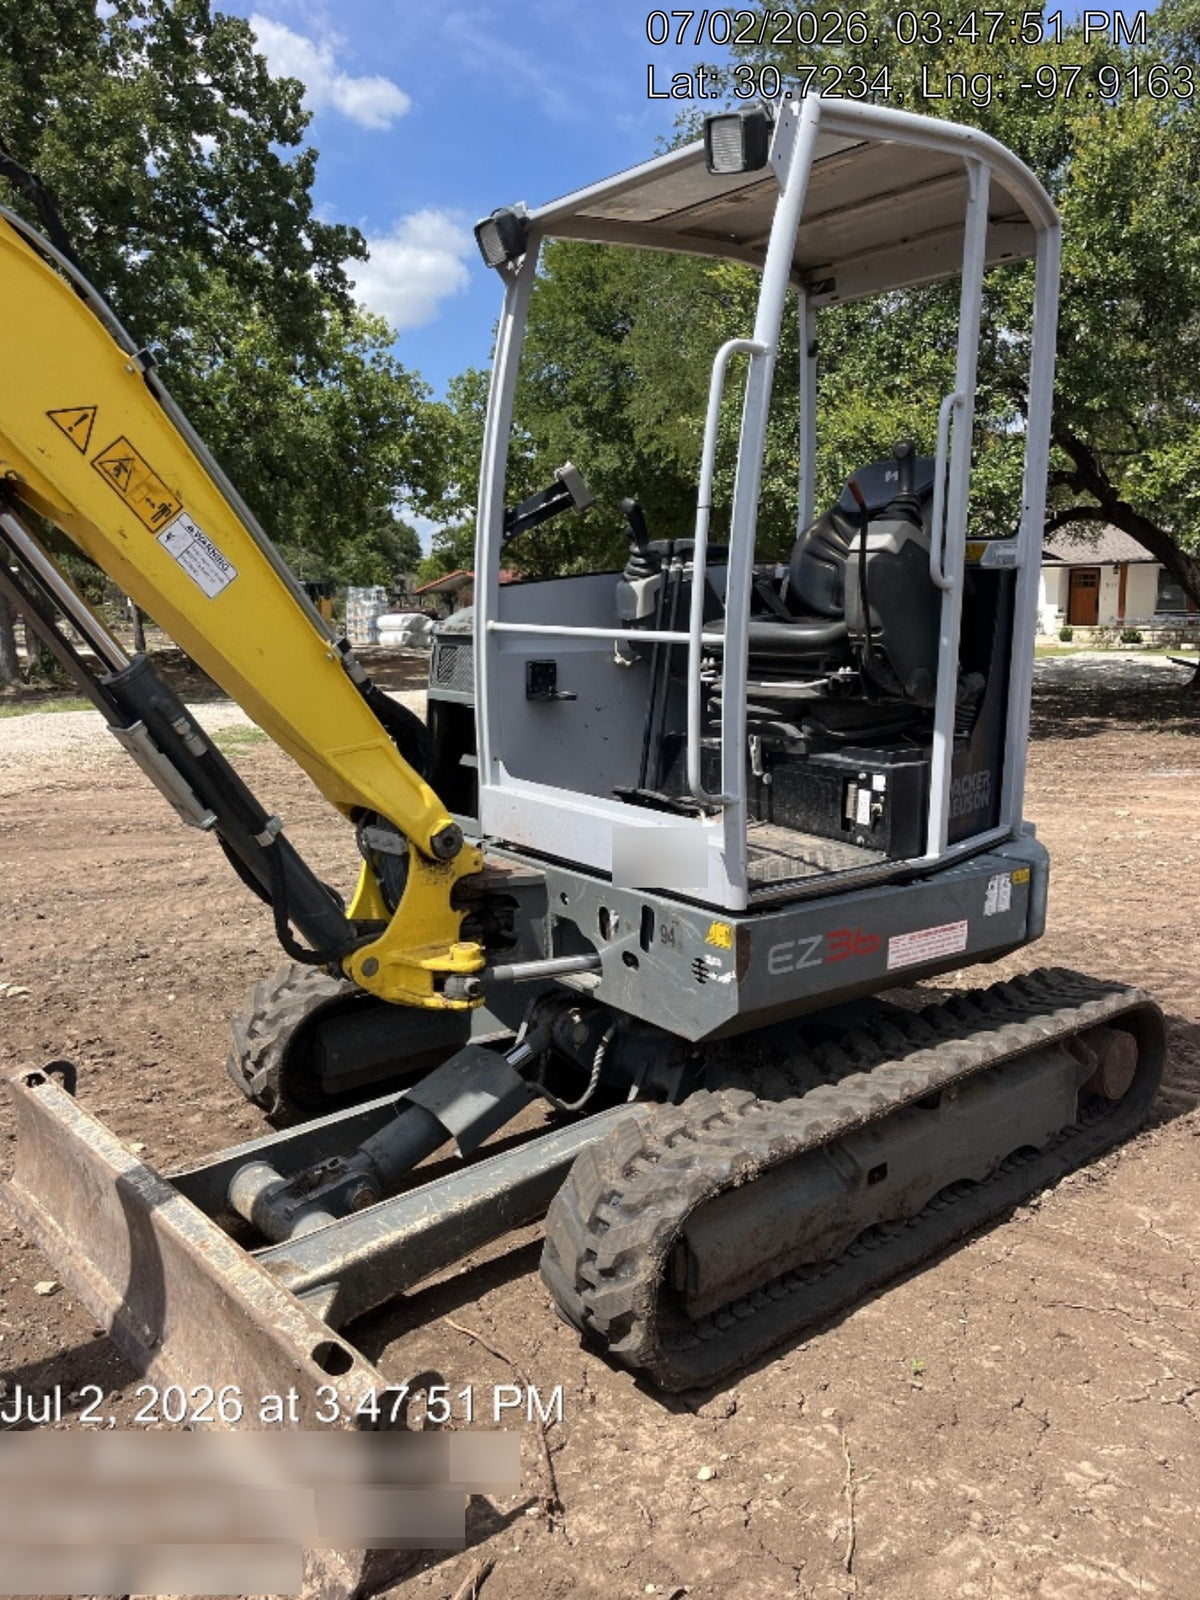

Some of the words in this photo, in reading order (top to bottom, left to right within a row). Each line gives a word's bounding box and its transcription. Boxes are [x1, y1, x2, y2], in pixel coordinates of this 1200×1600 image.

[950, 769, 991, 799] ACKER
[950, 789, 990, 818] EUSON
[767, 925, 882, 975] EZ36
